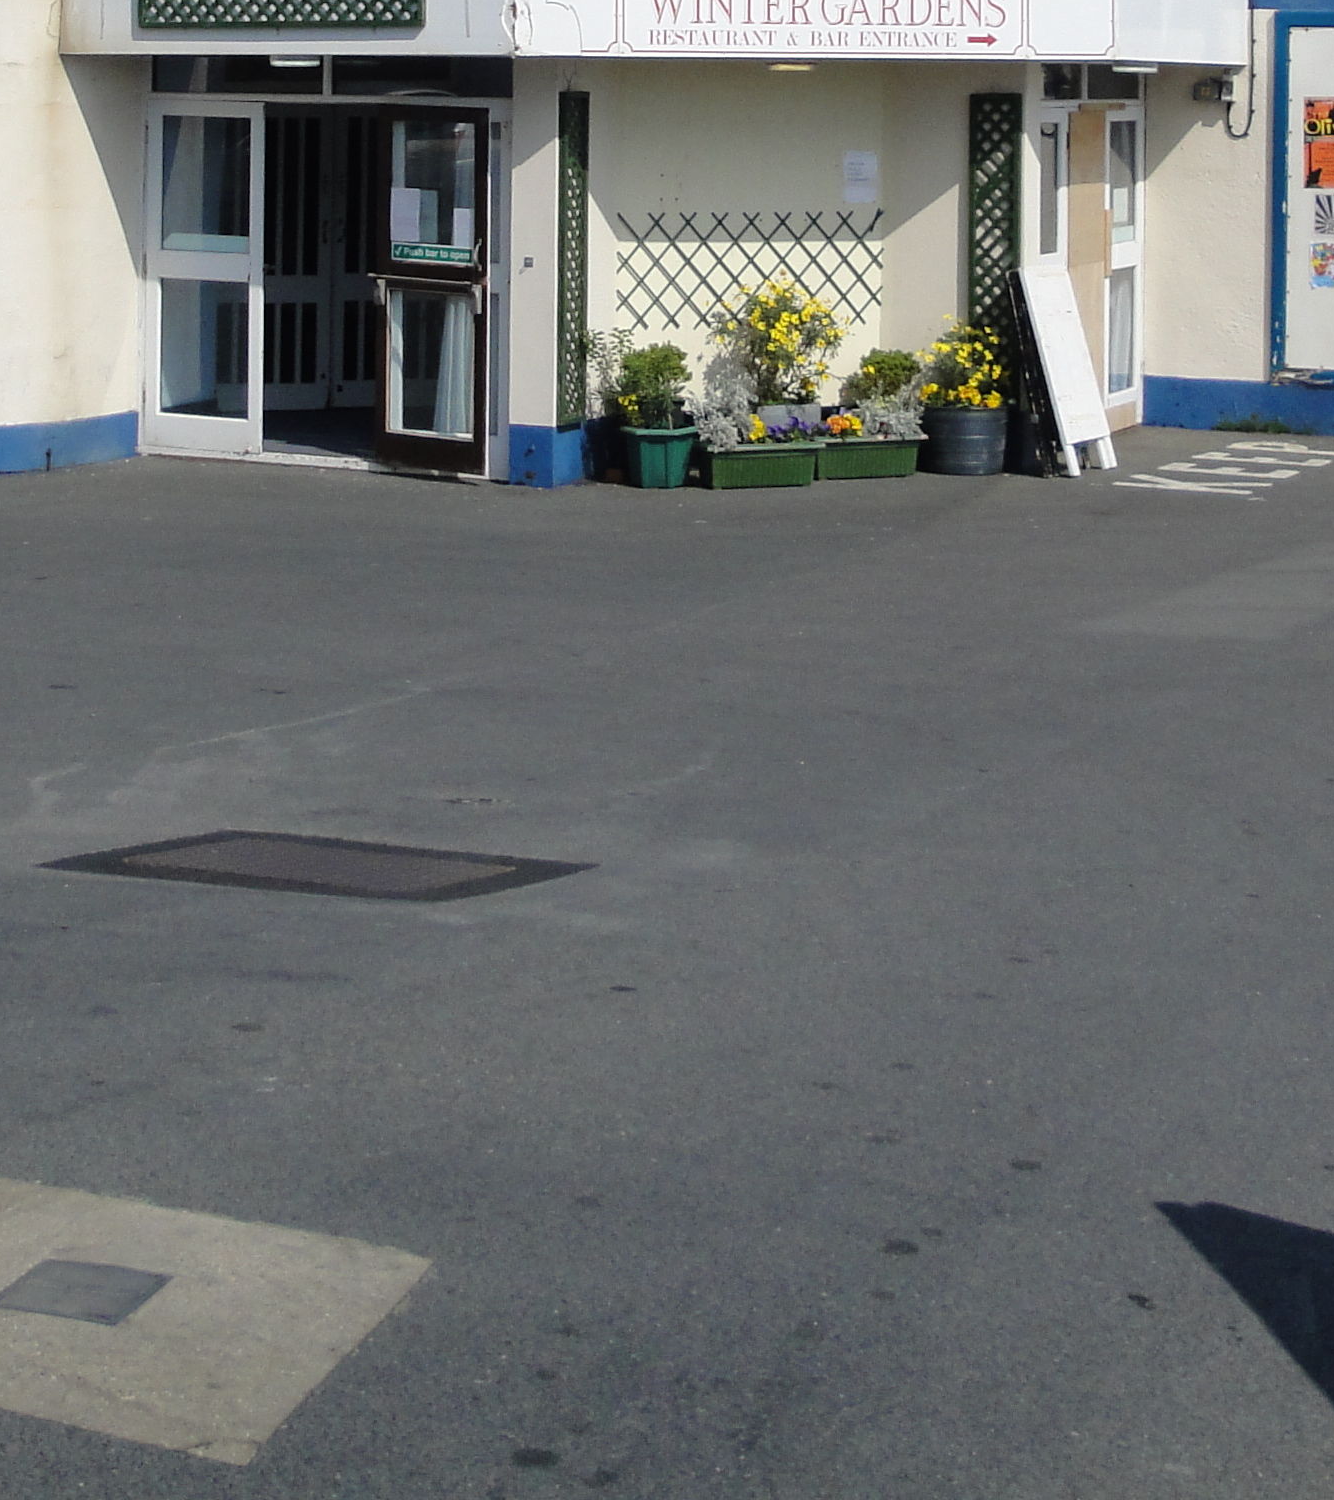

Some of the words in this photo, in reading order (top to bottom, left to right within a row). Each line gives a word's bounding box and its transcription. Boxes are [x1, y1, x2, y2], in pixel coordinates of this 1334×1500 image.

[648, 29, 778, 47] RESTAURANT
[786, 31, 800, 47] &
[810, 30, 849, 48] BAR
[859, 30, 958, 49] ENTRANCE
[403, 246, 424, 256] Push
[425, 248, 439, 258] bar
[440, 249, 449, 258] to
[450, 251, 471, 261] open
